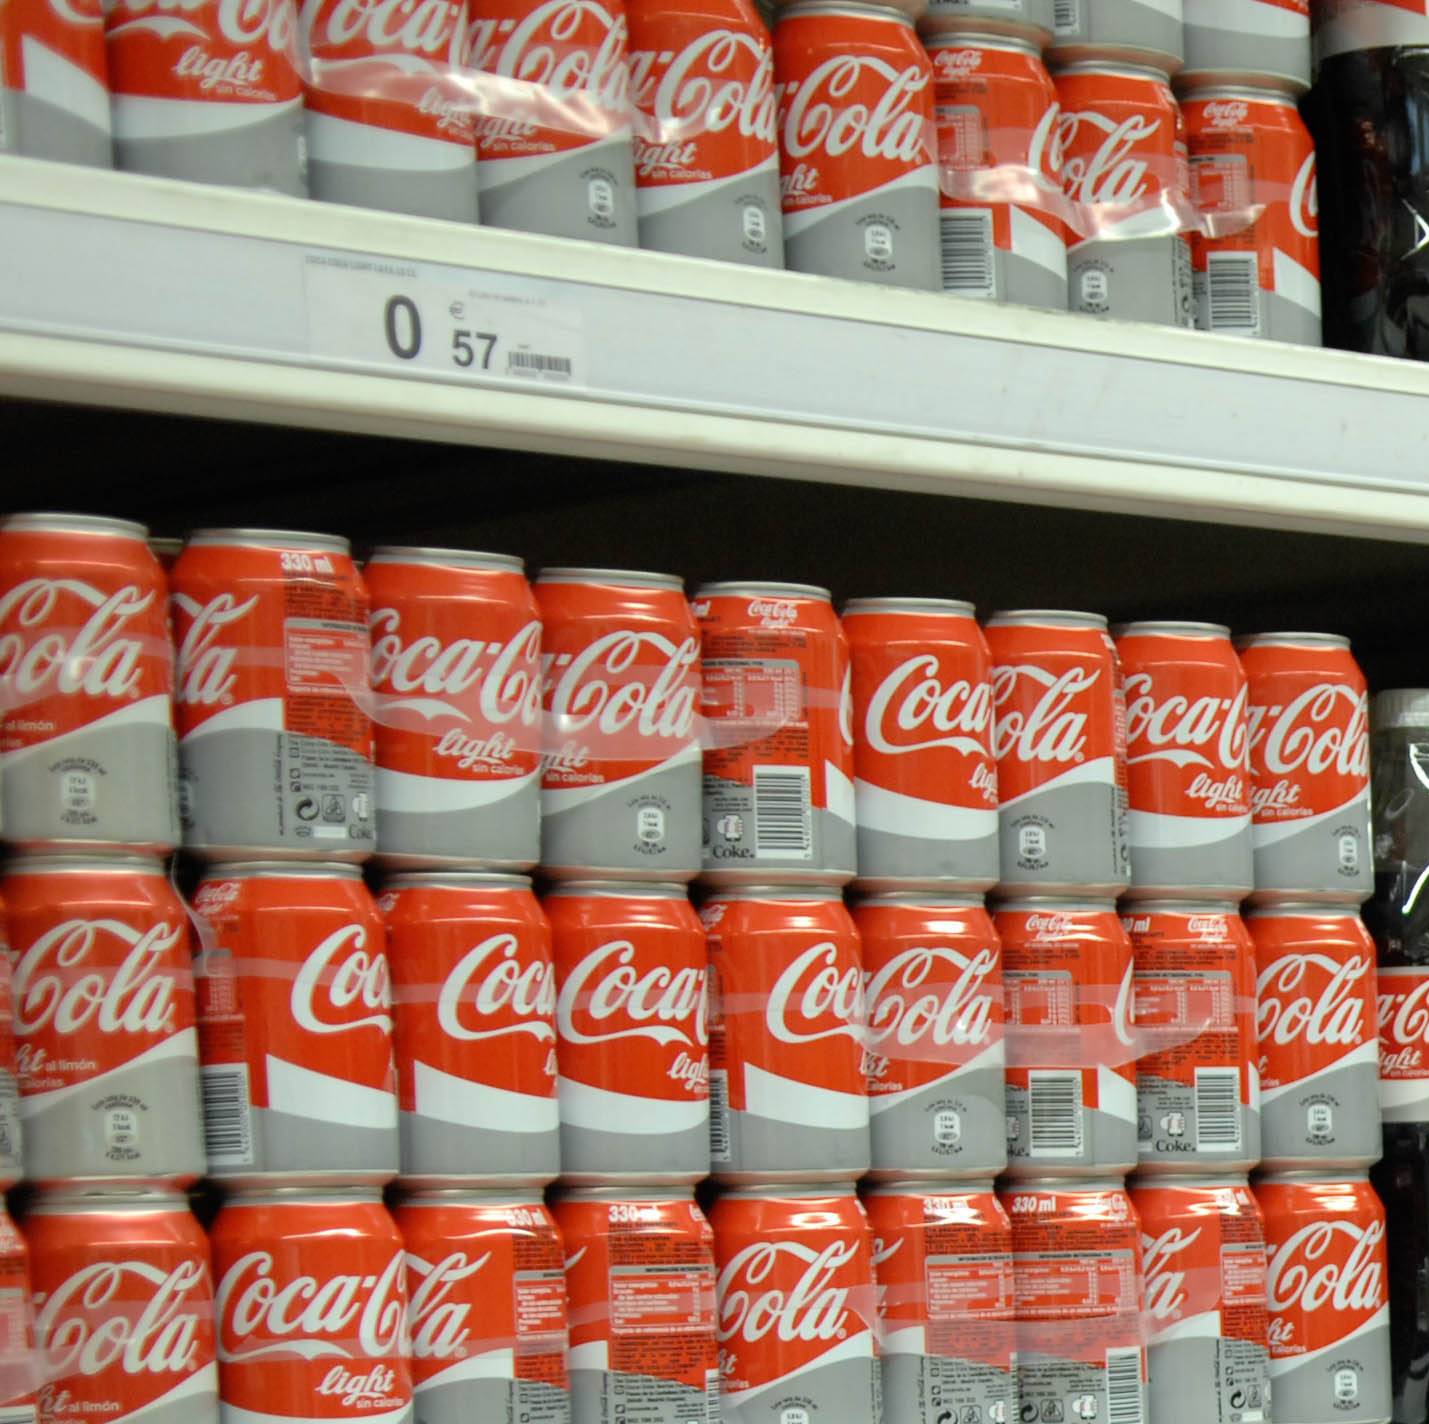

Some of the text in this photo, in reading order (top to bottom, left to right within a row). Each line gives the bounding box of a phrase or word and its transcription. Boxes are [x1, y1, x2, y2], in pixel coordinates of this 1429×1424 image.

[172, 46, 264, 90] light
[384, 294, 422, 360] 0
[452, 329, 498, 370] 57
[280, 552, 312, 572] 330
[434, 728, 513, 769] light
[1185, 772, 1244, 813] light
[59, 1057, 96, 1073] limón
[608, 1204, 635, 1223] 330
[1012, 1194, 1058, 1213] 330 ml
[315, 1364, 397, 1406] light
[81, 1398, 121, 1413] limón
